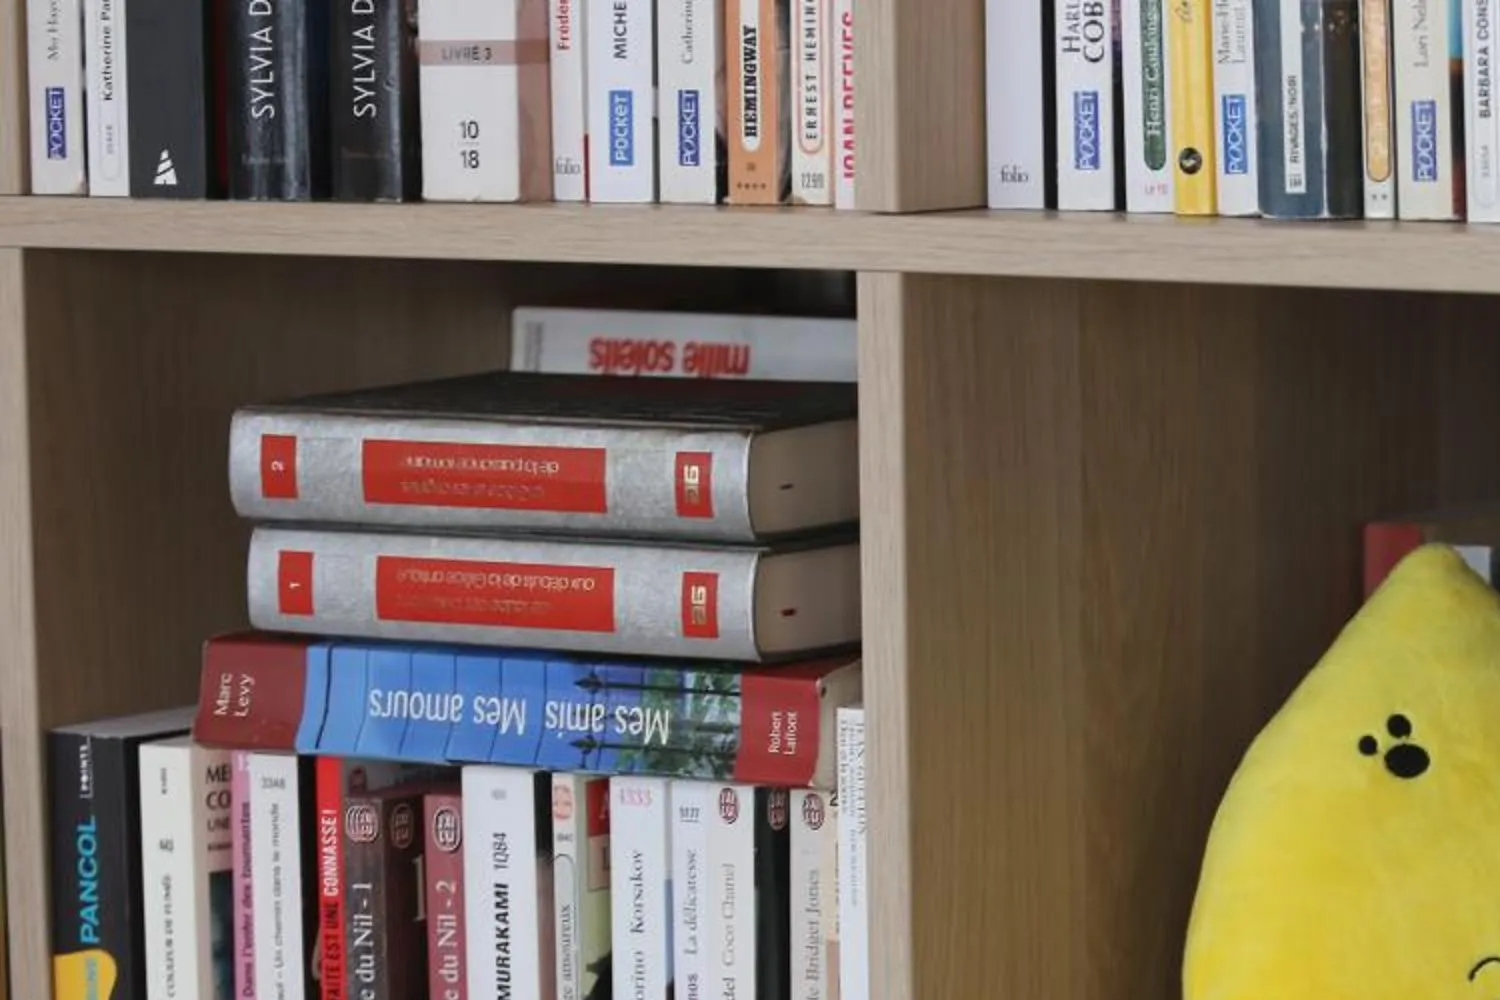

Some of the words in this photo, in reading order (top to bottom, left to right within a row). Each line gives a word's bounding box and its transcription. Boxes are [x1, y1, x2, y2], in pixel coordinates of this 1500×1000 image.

[103, 25, 115, 101] Katherine
[248, 26, 275, 119] SYLVIA
[352, 26, 377, 118] SYLVIA
[441, 46, 480, 61] LIVRE
[743, 25, 758, 138] HEMINGWAY
[1478, 47, 1492, 119] BARBARA
[612, 93, 632, 163] POCKET
[806, 74, 818, 140] ERNEST
[461, 120, 478, 138] 10
[681, 90, 698, 167] POCKET
[1077, 93, 1096, 170] POCKET
[1225, 97, 1243, 174] POCKET
[1416, 102, 1435, 181] POCKET
[462, 151, 478, 168] 18
[1001, 163, 1029, 183] folio
[589, 338, 678, 373] soleils
[682, 341, 751, 376] mille
[271, 460, 284, 471] 2
[213, 672, 234, 717] Marc
[234, 673, 256, 719] Levy
[370, 688, 462, 724] amours
[472, 695, 528, 737] Mes
[545, 701, 605, 738] amis
[616, 704, 670, 746] Mes
[768, 711, 783, 754] Robert
[784, 711, 800, 758] Laffont
[490, 832, 509, 869] 1Q84
[76, 815, 101, 945] PANCOL
[241, 884, 254, 910] des
[352, 882, 373, 891] 1
[435, 879, 456, 895] 2
[628, 850, 645, 935] Korsakov
[721, 863, 736, 919] Chanel
[801, 869, 820, 915] Jones
[321, 902, 340, 929] UNE
[352, 913, 374, 948] Nil
[435, 913, 458, 948] Nil
[322, 931, 341, 959] EST
[559, 904, 574, 982] amoureux
[683, 935, 699, 956] La
[721, 924, 735, 968] Coco
[802, 919, 822, 982] Bridget
[243, 962, 256, 998] Dans
[354, 953, 376, 985] du
[438, 954, 460, 985] du
